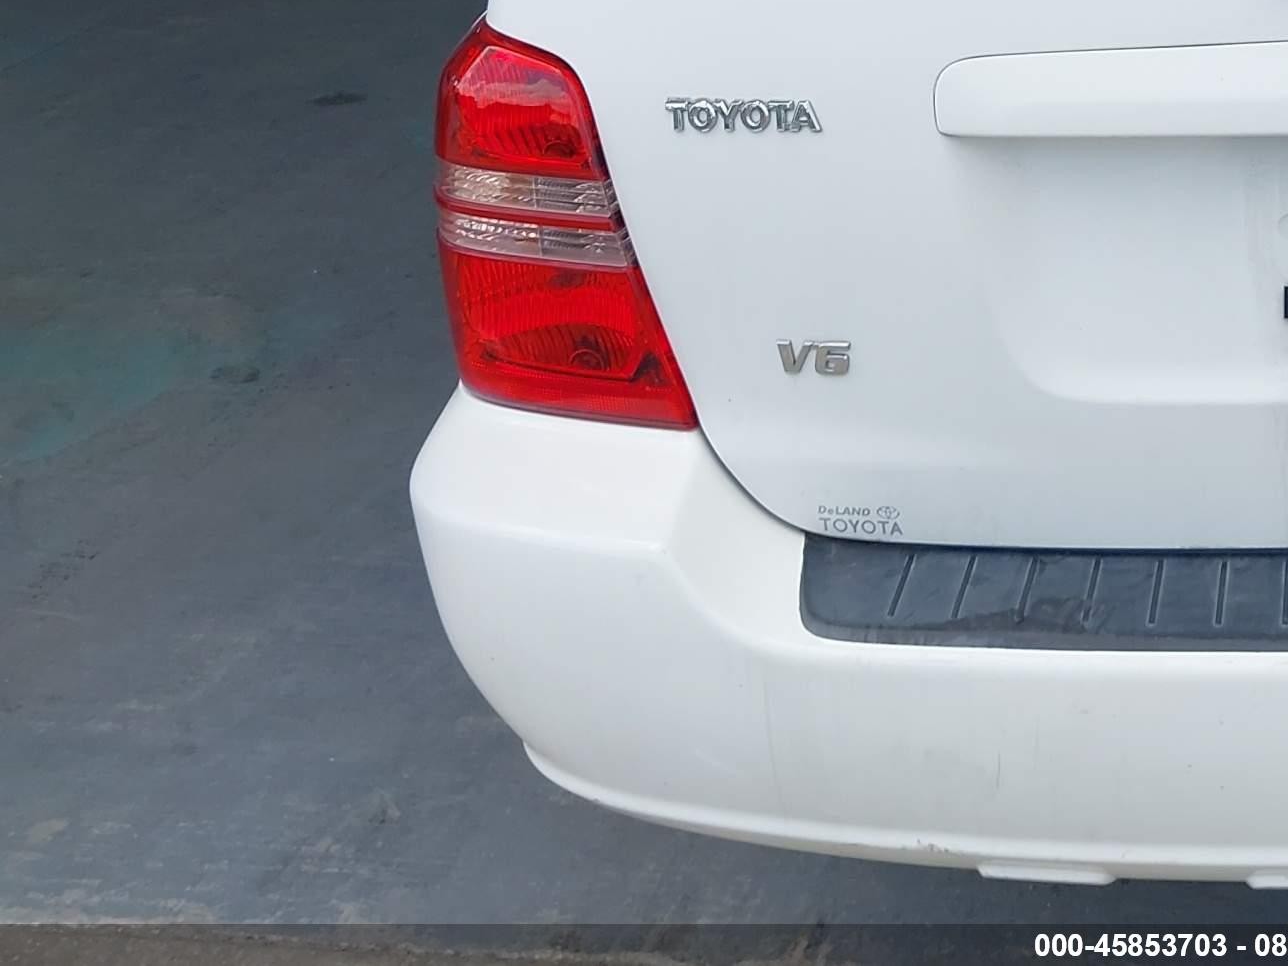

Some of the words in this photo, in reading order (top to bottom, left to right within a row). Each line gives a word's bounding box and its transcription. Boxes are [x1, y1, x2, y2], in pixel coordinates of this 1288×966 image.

[665, 97, 823, 133] TOYOTA
[776, 338, 851, 375] V6
[818, 505, 871, 516] DeLAND
[818, 517, 903, 535] TOYOTA
